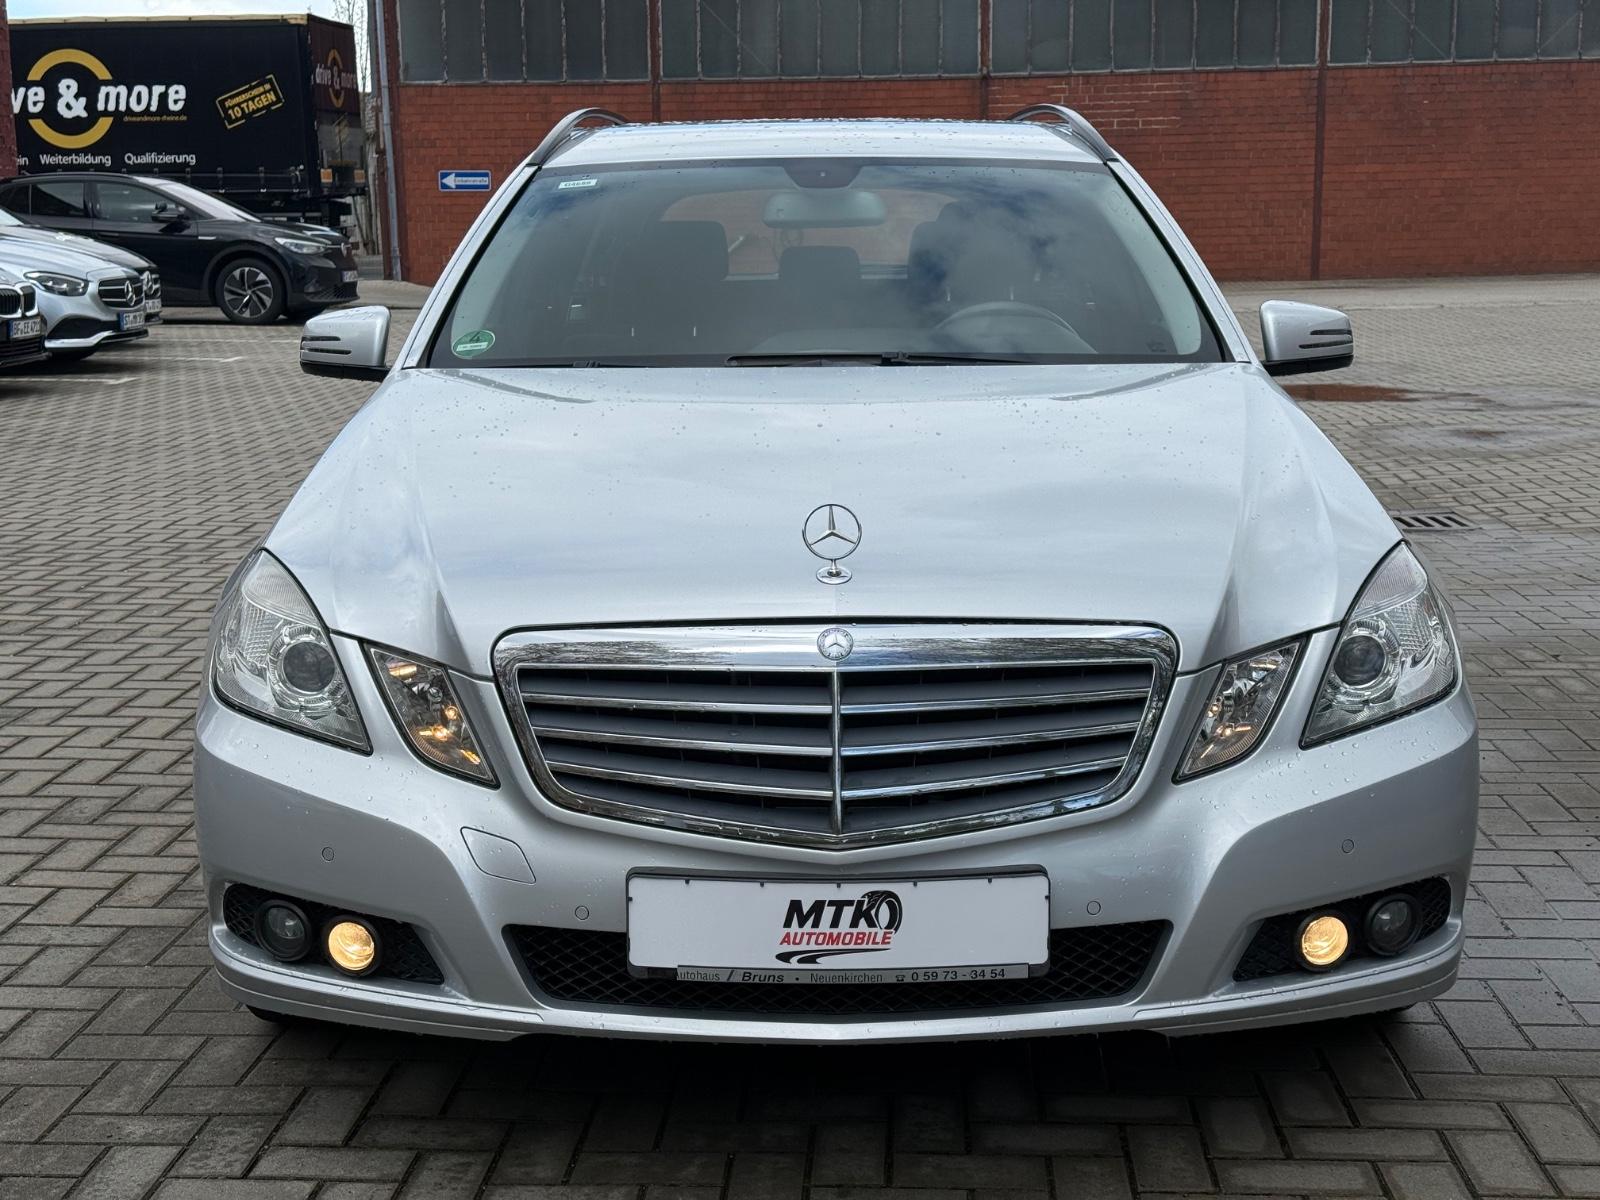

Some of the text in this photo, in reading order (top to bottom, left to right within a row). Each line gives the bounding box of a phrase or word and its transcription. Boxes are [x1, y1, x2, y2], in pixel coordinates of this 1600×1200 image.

[315, 63, 331, 86] drive
[57, 78, 88, 118] &
[97, 84, 187, 112] more
[227, 91, 277, 120] 10 TAGEN
[39, 154, 112, 167] Weiterbildung
[124, 152, 196, 165] Qualifizierung
[779, 931, 894, 946] AUTOMOBILE
[742, 972, 785, 983] Bruns
[810, 973, 883, 984] Neuenkirchen
[923, 971, 938, 981] 59
[943, 971, 958, 980] 73
[970, 969, 986, 979] 34
[991, 968, 1006, 979] 54
